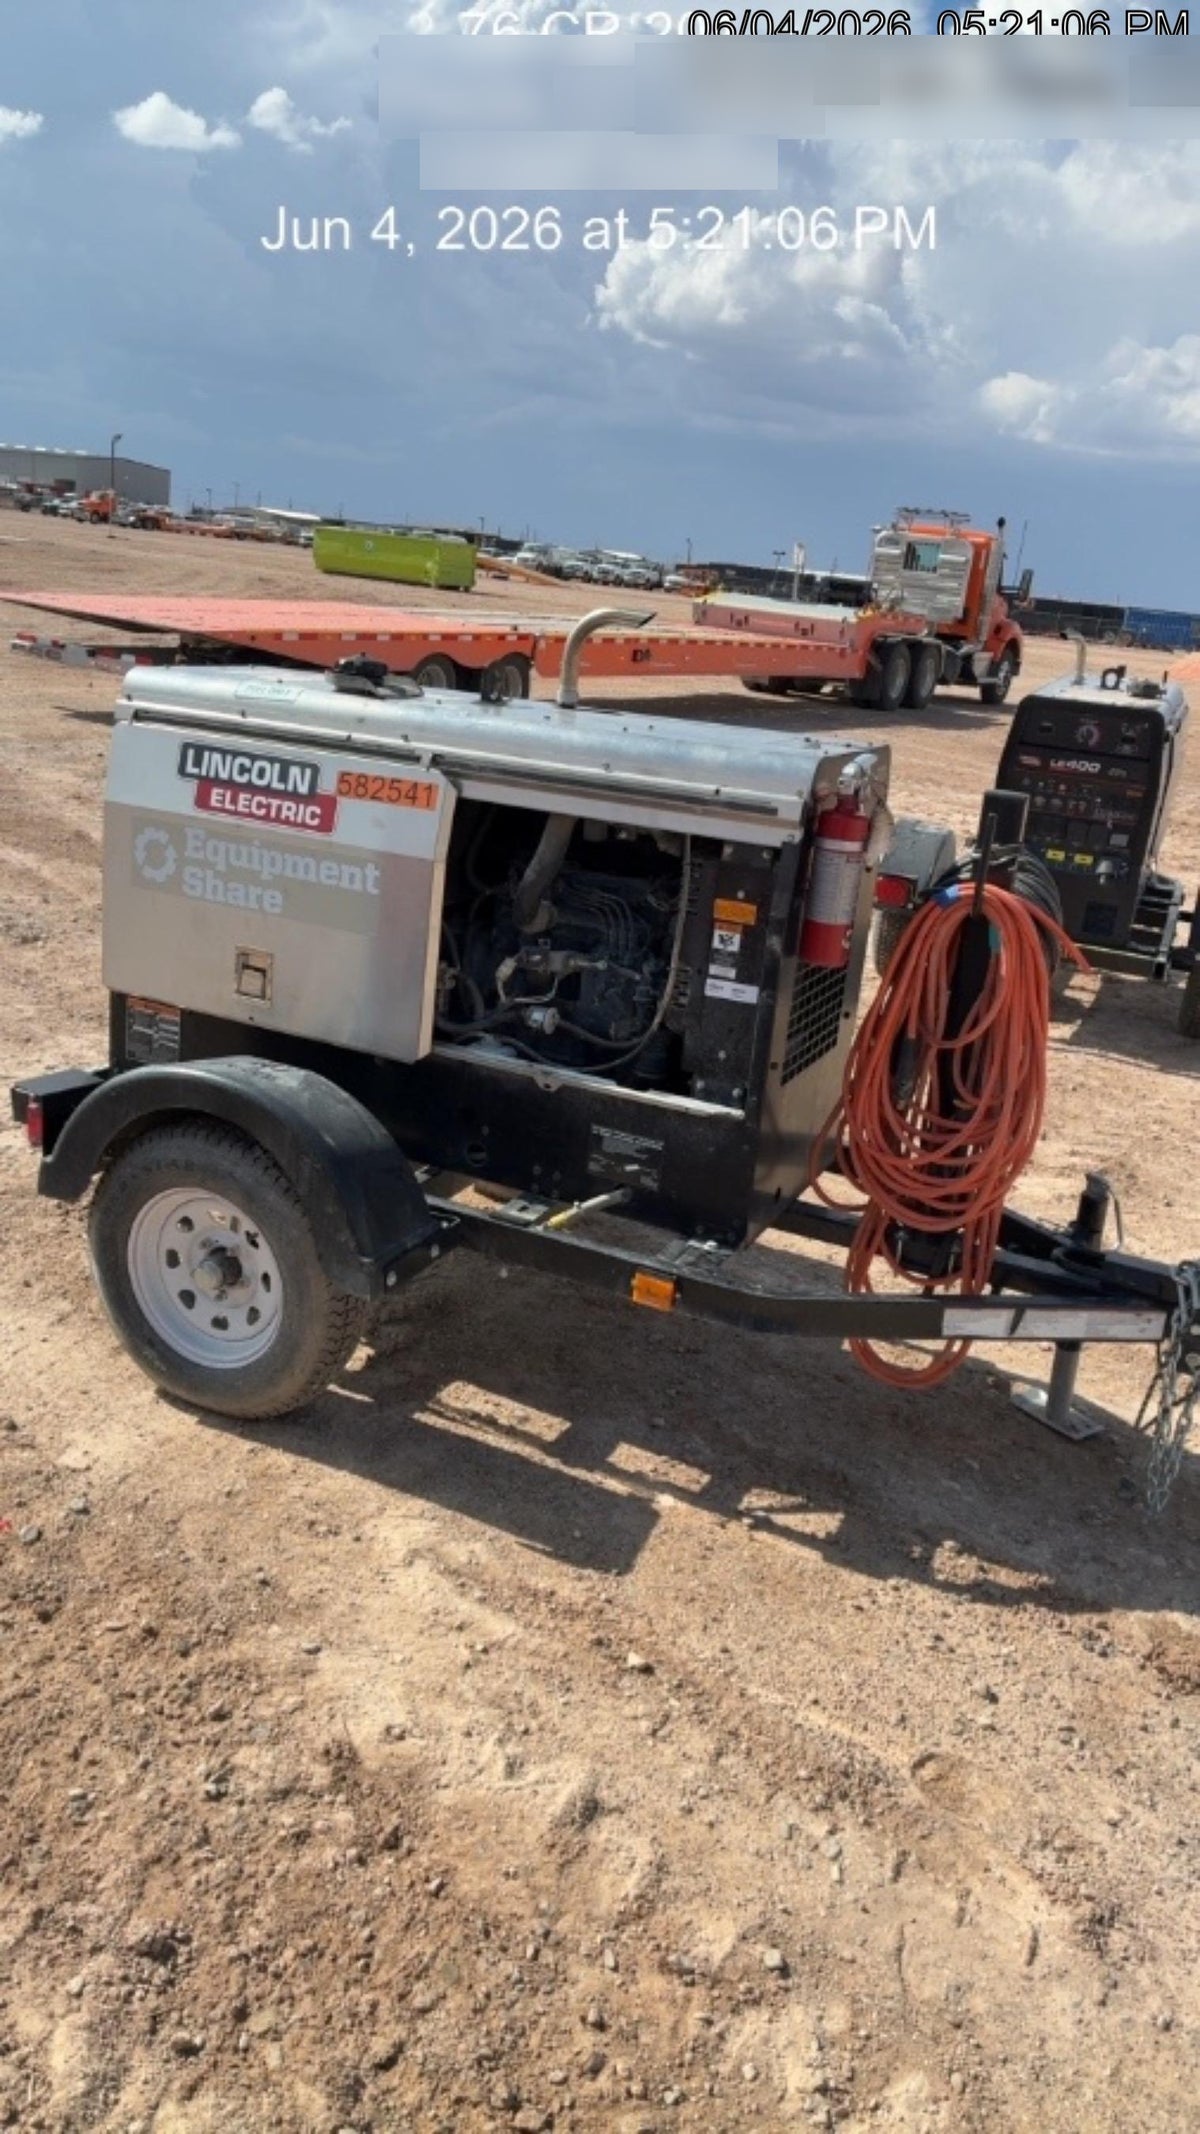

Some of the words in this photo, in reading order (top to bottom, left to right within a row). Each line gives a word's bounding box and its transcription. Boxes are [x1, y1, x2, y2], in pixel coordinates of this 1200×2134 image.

[184, 749, 312, 795] LINCOLN
[338, 772, 433, 807] 582541
[210, 787, 322, 826] ELECTRIC
[184, 827, 381, 895] Equipment
[182, 866, 284, 913] Share
